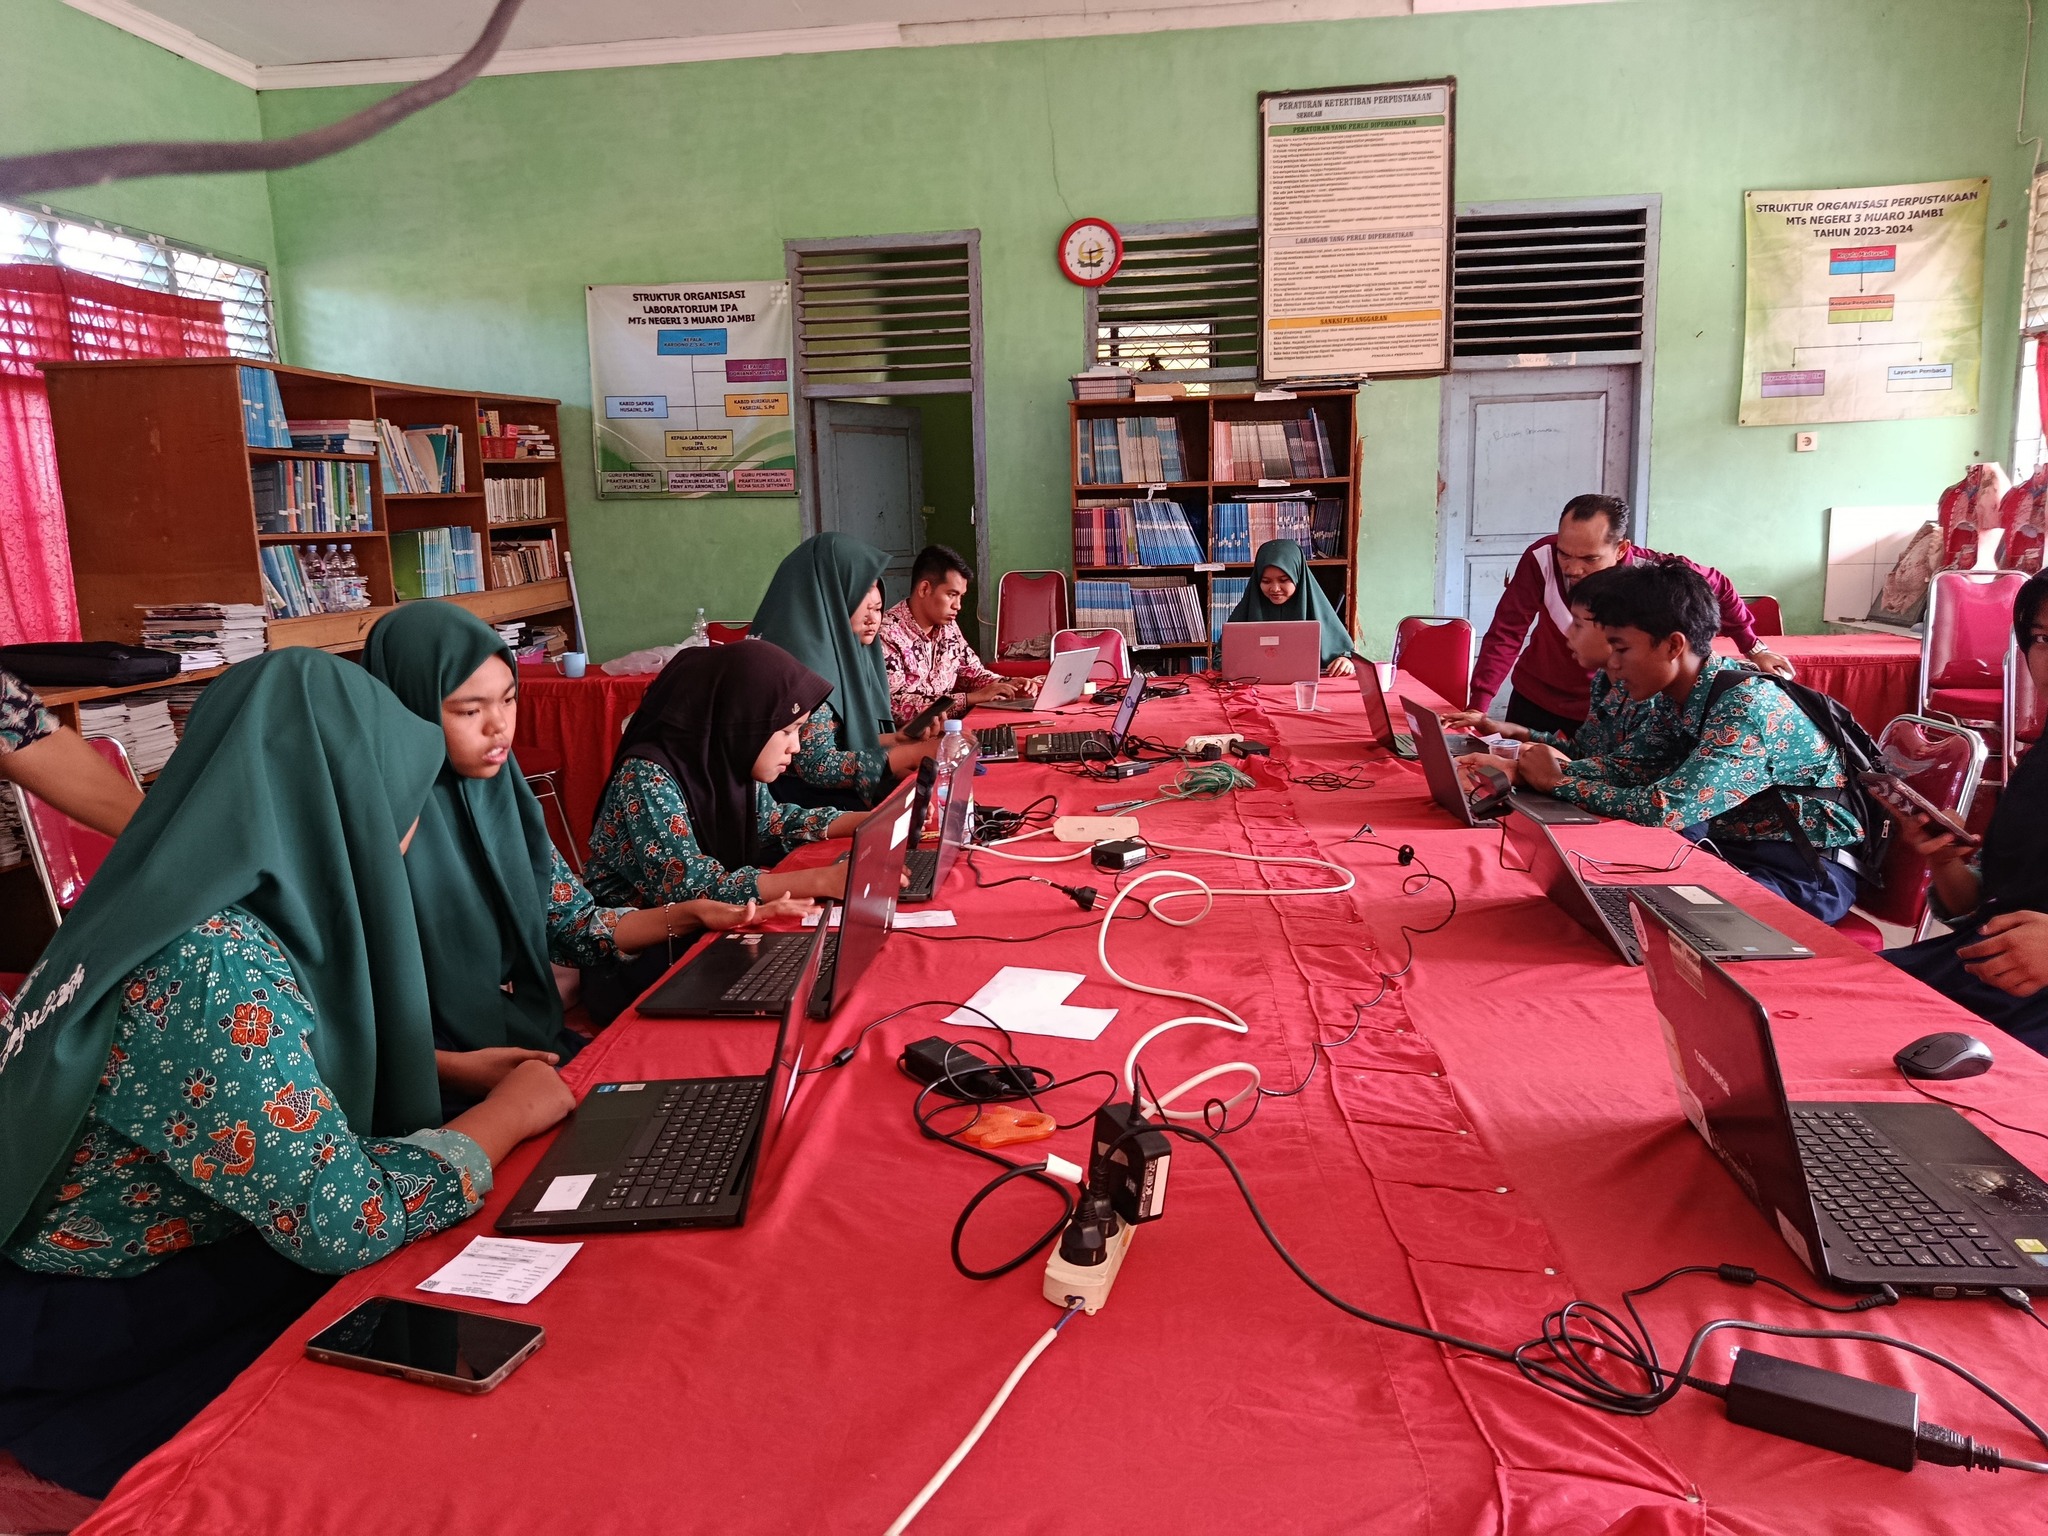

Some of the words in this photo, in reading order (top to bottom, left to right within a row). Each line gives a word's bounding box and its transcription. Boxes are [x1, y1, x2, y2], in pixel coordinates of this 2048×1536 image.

[1278, 100, 1322, 110] PERATURAN
[1325, 96, 1372, 107] KETERTIBAN
[1374, 92, 1432, 104] PERPUSTAKAAN
[1293, 125, 1330, 133] PERATURAN
[1370, 120, 1417, 128] DIPERHATIKAN
[1756, 203, 1813, 213] STRUKTUR
[1816, 199, 1888, 211] ORGANISASI
[1891, 191, 1978, 207] PERPUSTAKAAN
[1786, 217, 1806, 225] MTs
[1810, 214, 1852, 224] NEGERI
[1854, 214, 1861, 223] 3
[1864, 212, 1905, 222] MUARO
[1907, 208, 1944, 220] JAMBI
[1368, 231, 1414, 239] DIPERHATIKAN
[1813, 228, 1851, 237] TAHUN
[1854, 224, 1913, 236] 2023-2024
[632, 293, 682, 302] STRUKTUR
[684, 290, 746, 300] ORGANISASI
[643, 304, 718, 314] LABORATORIUM
[720, 304, 738, 312] IPA
[628, 317, 646, 325] MTs
[648, 317, 681, 325] NEGERI
[683, 316, 689, 324] 3
[691, 315, 724, 324] MUARO
[727, 314, 755, 323] JAMBI
[1343, 315, 1388, 323] PELANGGARAN
